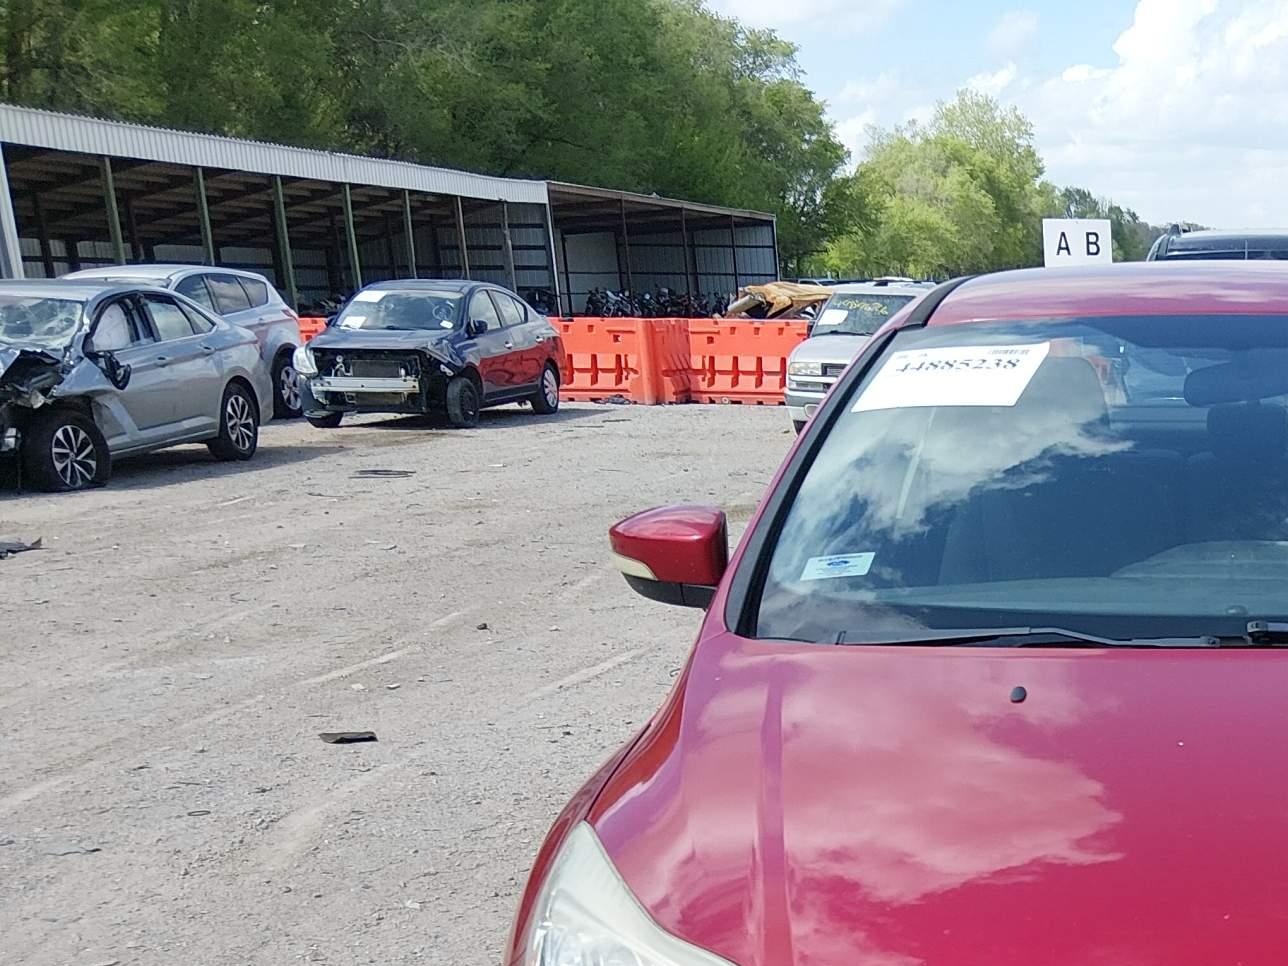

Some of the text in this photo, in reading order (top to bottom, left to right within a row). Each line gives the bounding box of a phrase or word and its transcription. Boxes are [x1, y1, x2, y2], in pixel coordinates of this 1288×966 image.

[1056, 231, 1100, 256] A B
[895, 357, 1021, 373] 44885238
